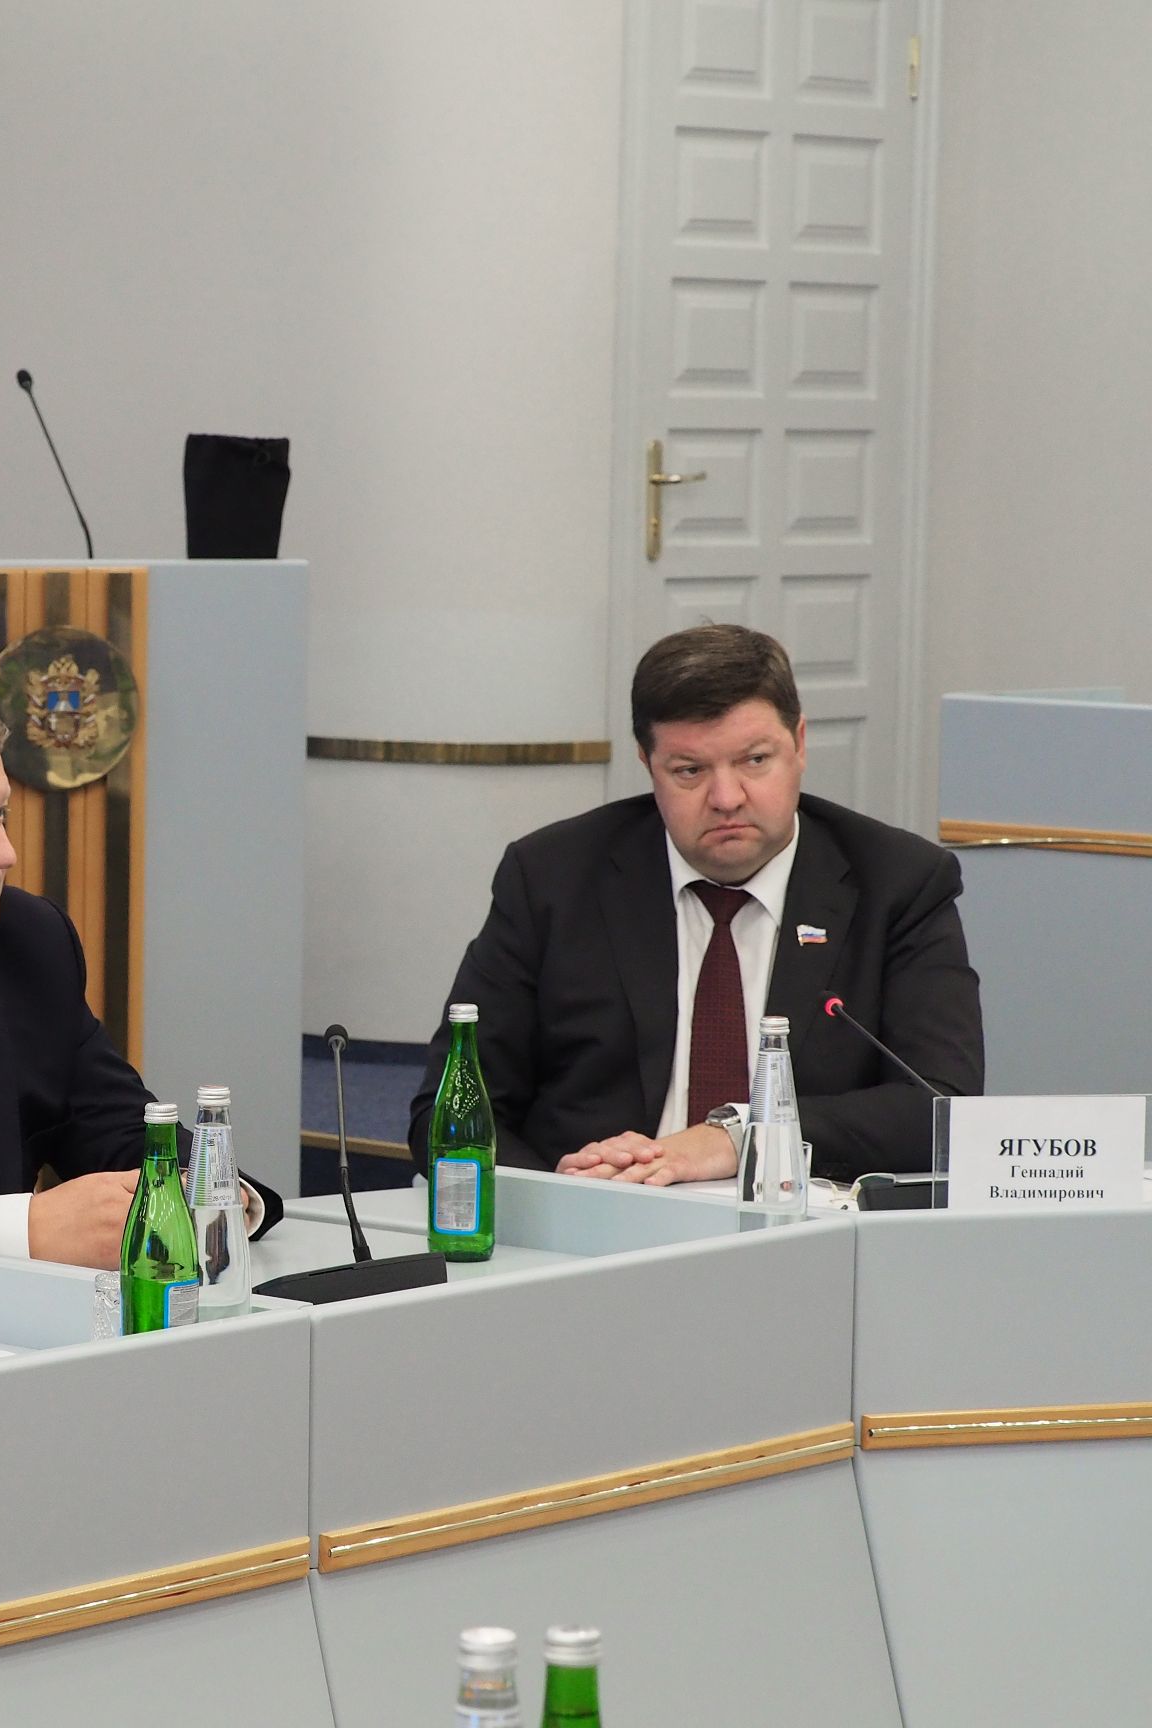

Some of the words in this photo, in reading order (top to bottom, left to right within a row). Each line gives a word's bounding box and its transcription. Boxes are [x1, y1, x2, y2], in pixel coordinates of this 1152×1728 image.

[998, 1138, 1097, 1157] ЯГУБОВ
[1010, 1165, 1084, 1179] Геннадий
[990, 1185, 1104, 1202] Владимирович
